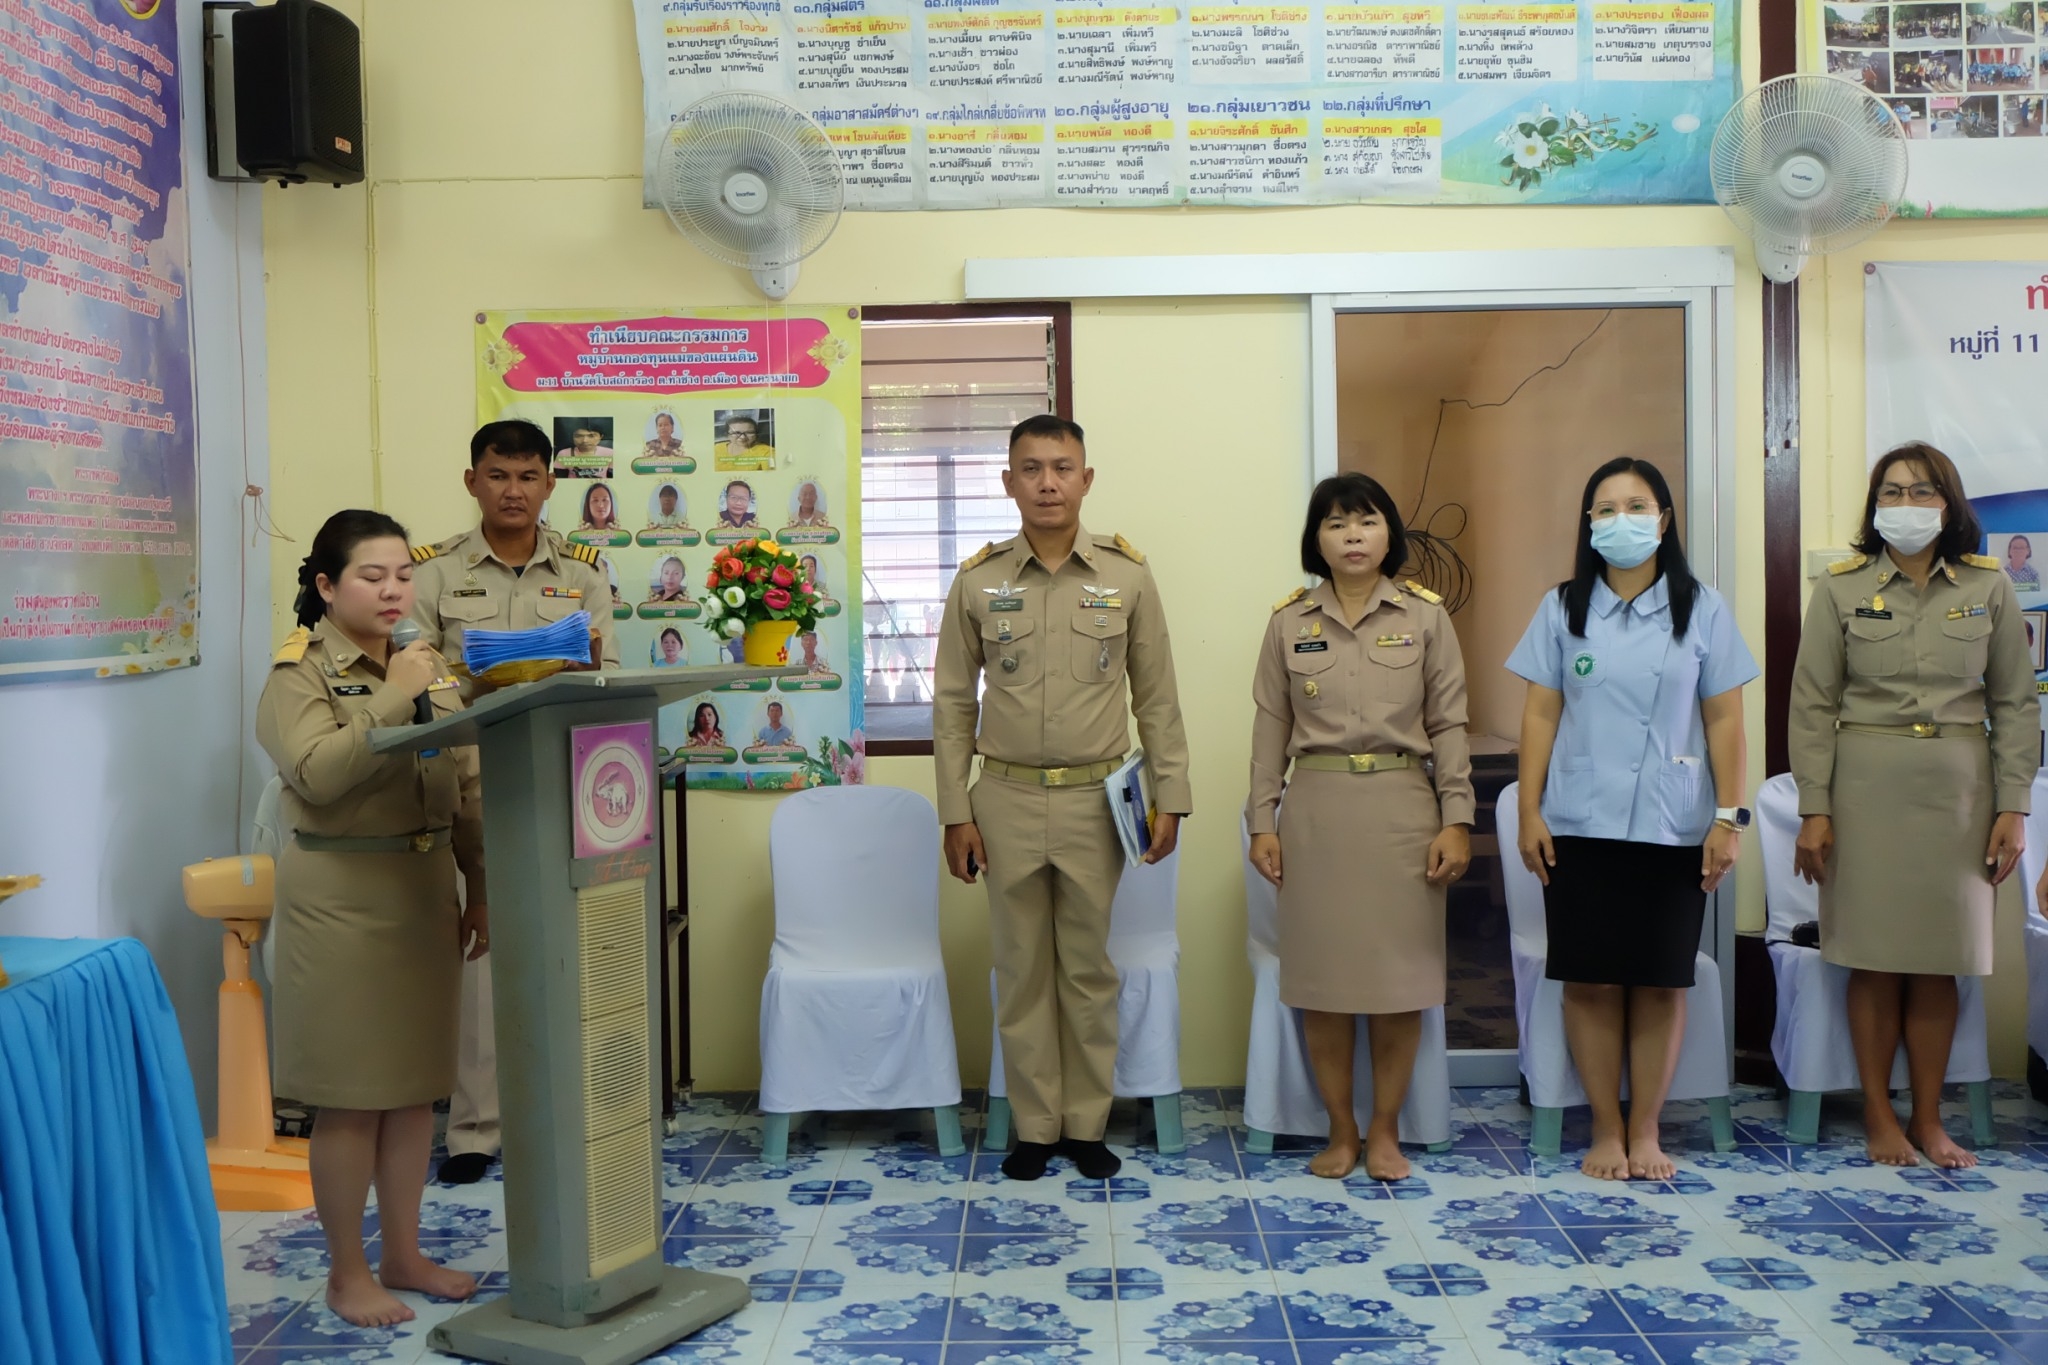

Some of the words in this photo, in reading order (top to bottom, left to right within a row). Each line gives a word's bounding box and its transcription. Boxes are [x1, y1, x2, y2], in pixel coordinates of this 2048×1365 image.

[1055, 99, 1169, 121] ๒๐.กลุ่มผู้สูงอายุ
[1188, 98, 1310, 118] ๒๑.กลุ่มเยาวชน
[1323, 92, 1430, 117] ๒๒.กลุ่มที่ปรึกษา
[1123, 125, 1151, 136] ทองดี
[1117, 156, 1143, 167] ทองดี
[1120, 171, 1144, 180] ทองดี
[589, 326, 747, 343] ทำเนียบคณะกรรมการ
[1950, 325, 1999, 360] หมู่ที่
[2013, 334, 2039, 353] 11
[578, 348, 758, 368] หมู่บ้านกองทุนแม่ของแผ่นดิน
